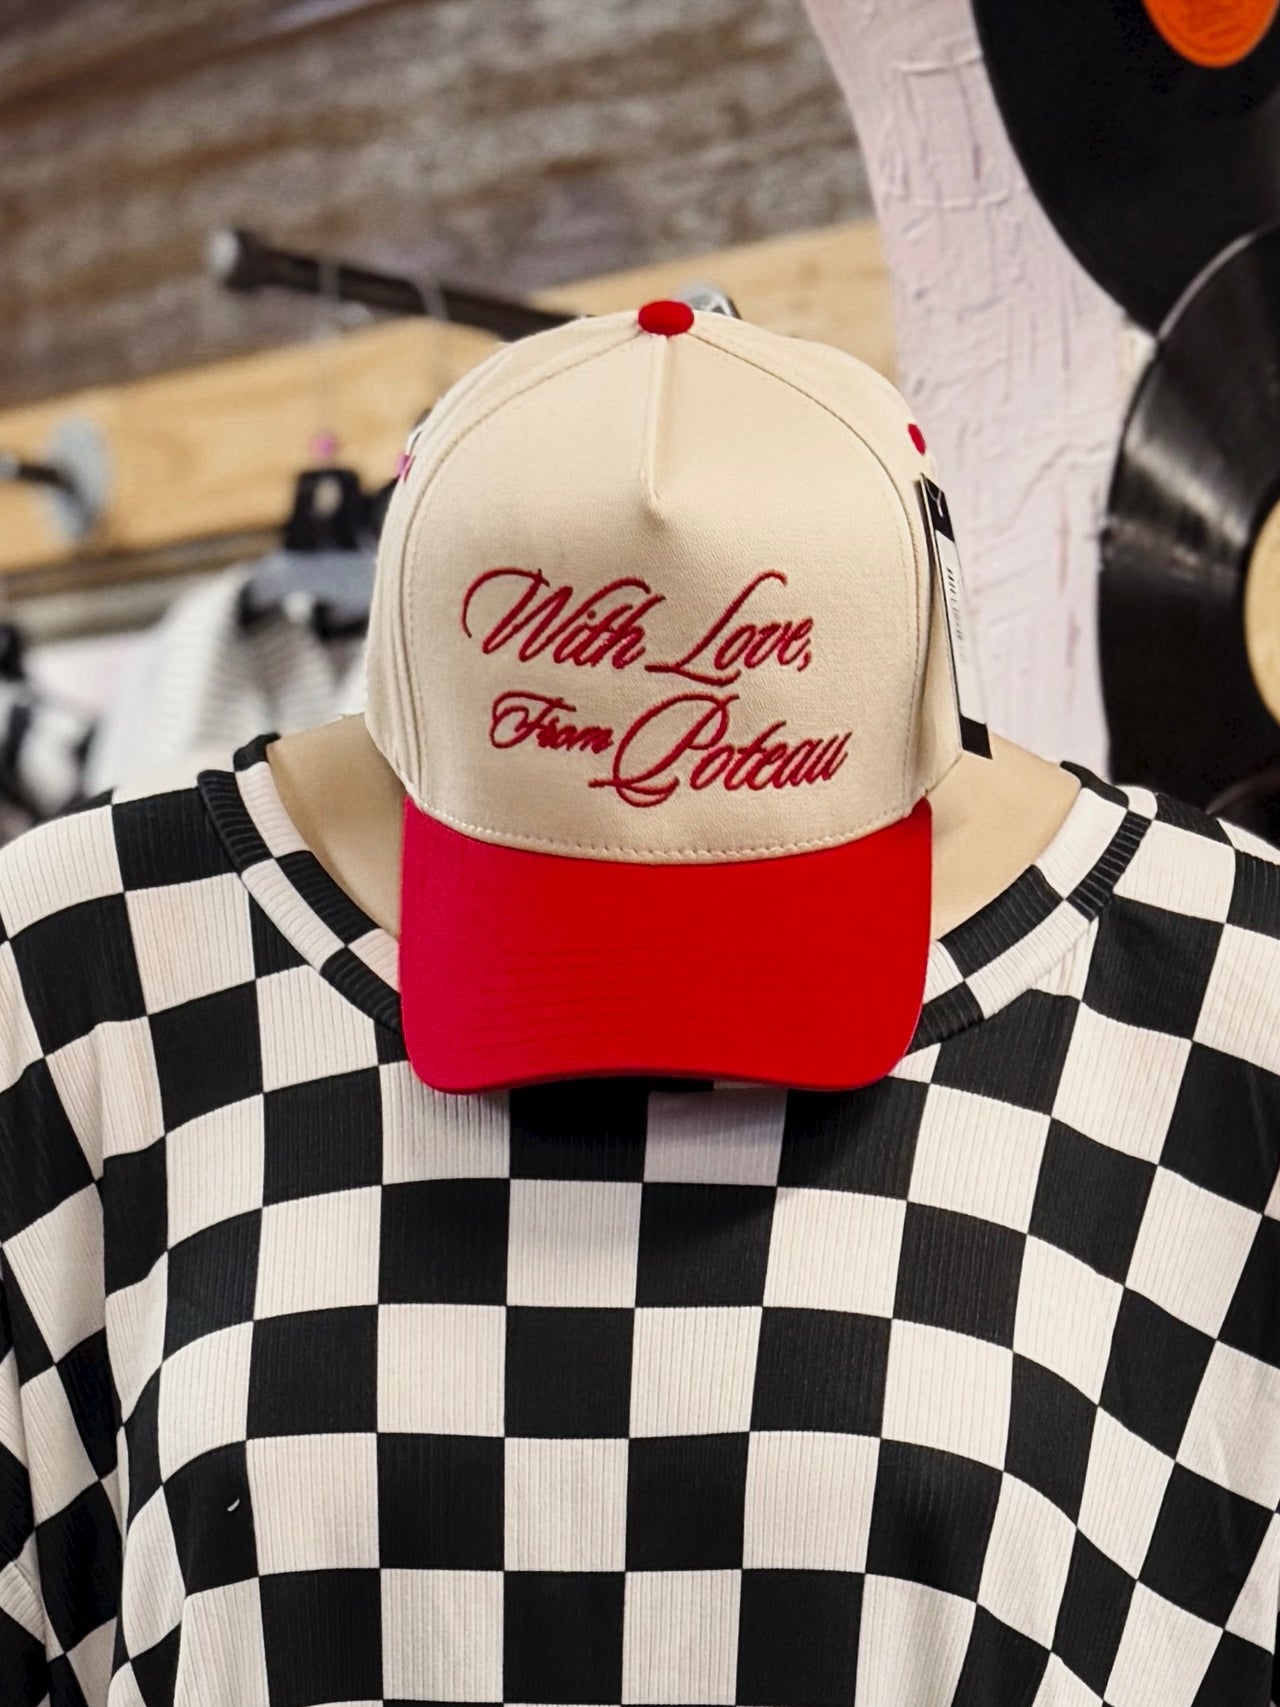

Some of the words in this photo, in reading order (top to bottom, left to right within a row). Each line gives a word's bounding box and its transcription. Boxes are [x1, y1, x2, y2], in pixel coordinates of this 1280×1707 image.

[461, 568, 666, 669] With
[645, 570, 814, 687] Love,
[489, 690, 614, 753] From
[588, 693, 852, 808] Poteau
